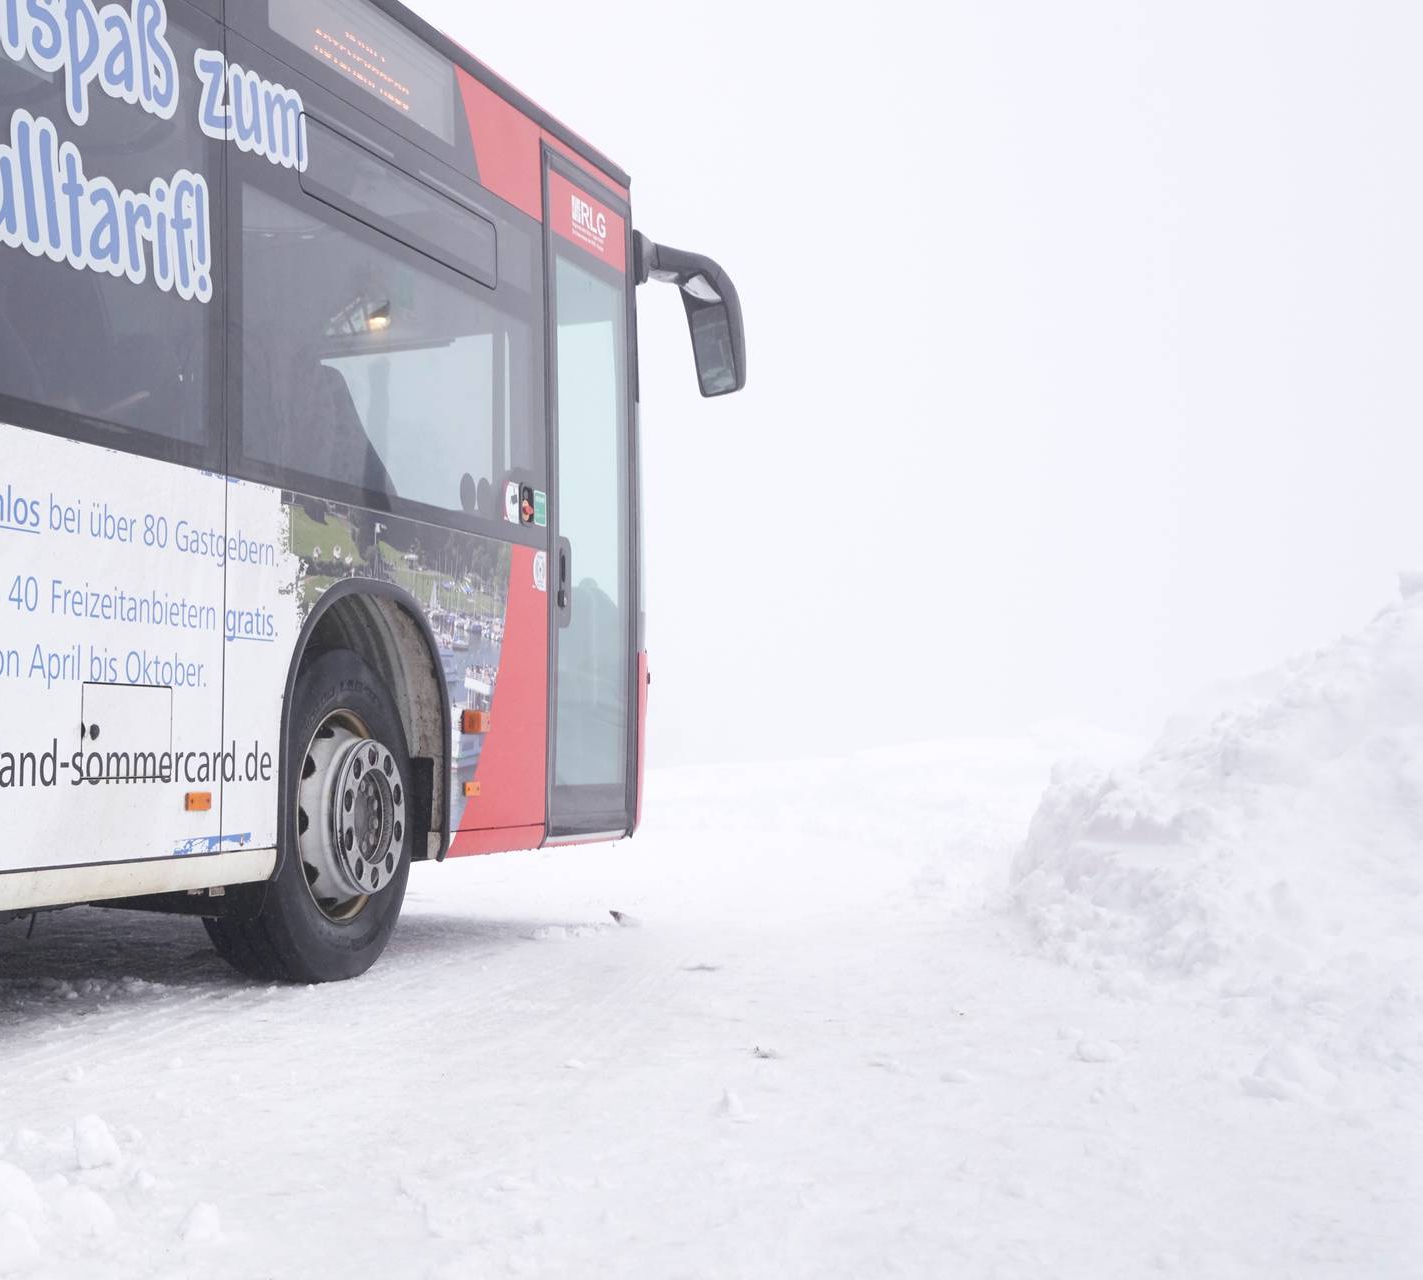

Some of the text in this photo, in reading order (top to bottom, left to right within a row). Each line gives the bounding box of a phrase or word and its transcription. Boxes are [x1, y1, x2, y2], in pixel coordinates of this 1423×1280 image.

[197, 54, 305, 167] zum
[580, 200, 607, 239] RLG
[49, 493, 81, 534] bei
[90, 502, 137, 543] über
[143, 514, 168, 548] 80
[176, 521, 279, 567] Gastgebern.
[8, 575, 38, 611] 40
[51, 579, 216, 632] Freizeitanbietern
[226, 605, 278, 641] gratis.
[29, 645, 81, 689] April
[90, 646, 118, 683] bis
[126, 651, 207, 687] Oktober.
